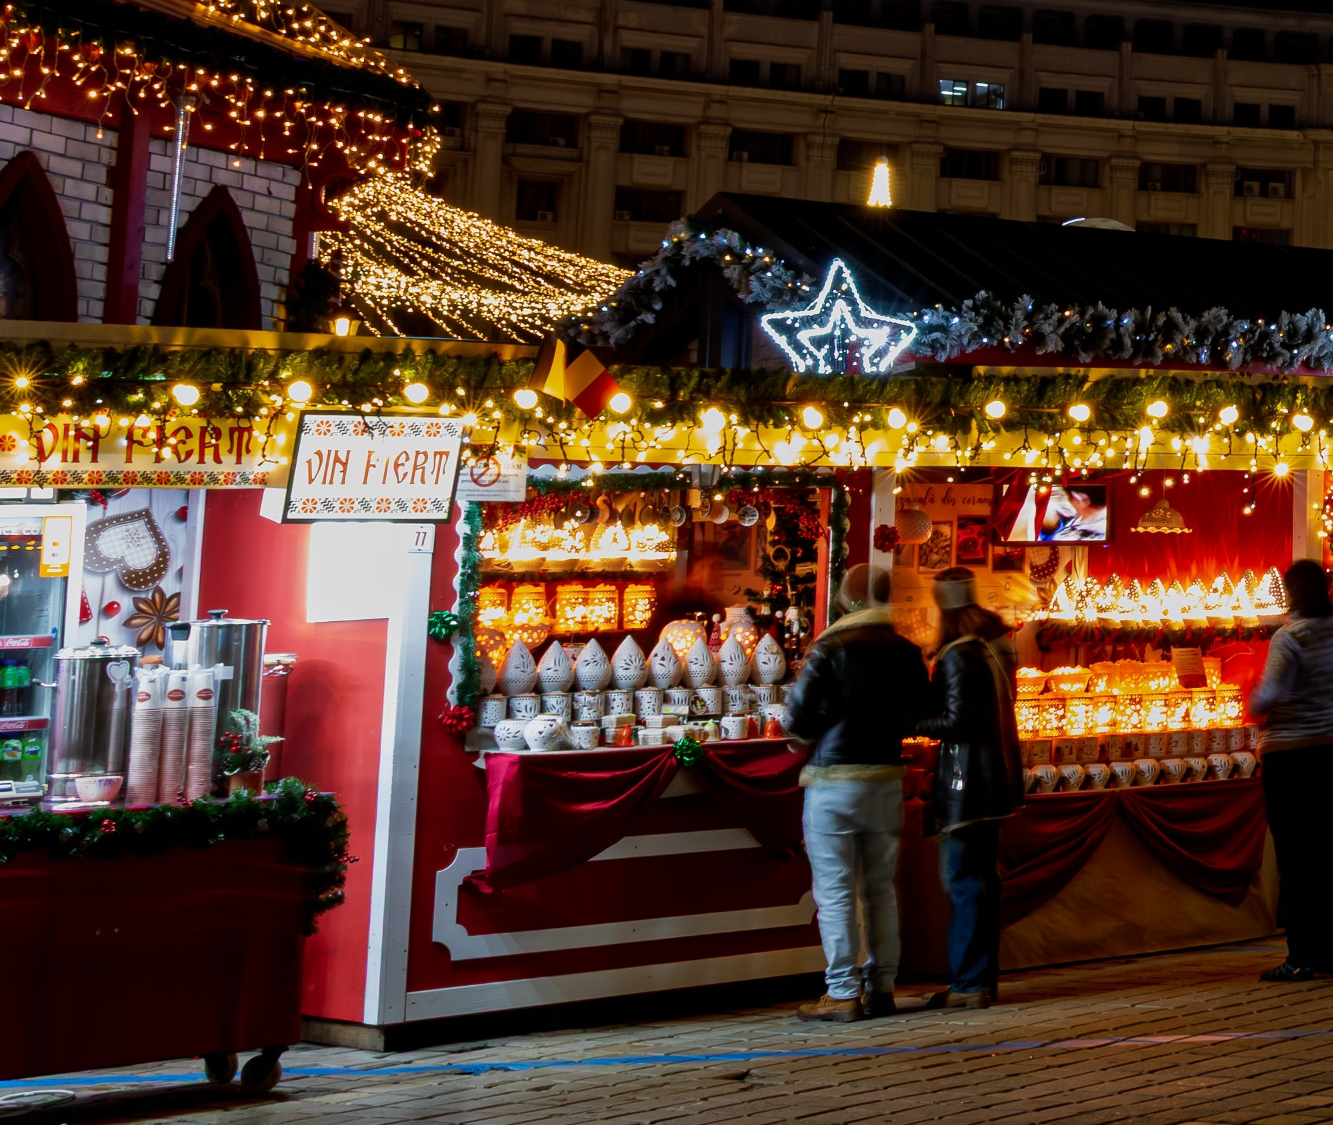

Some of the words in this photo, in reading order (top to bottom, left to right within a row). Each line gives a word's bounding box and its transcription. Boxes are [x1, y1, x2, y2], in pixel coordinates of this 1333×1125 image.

[35, 422, 100, 464] VIN
[125, 425, 254, 465] FIERT
[305, 448, 352, 486] VIN
[362, 449, 451, 486] FIERT
[941, 487, 956, 505] din
[962, 495, 995, 507] ceram
[415, 531, 428, 547] 77
